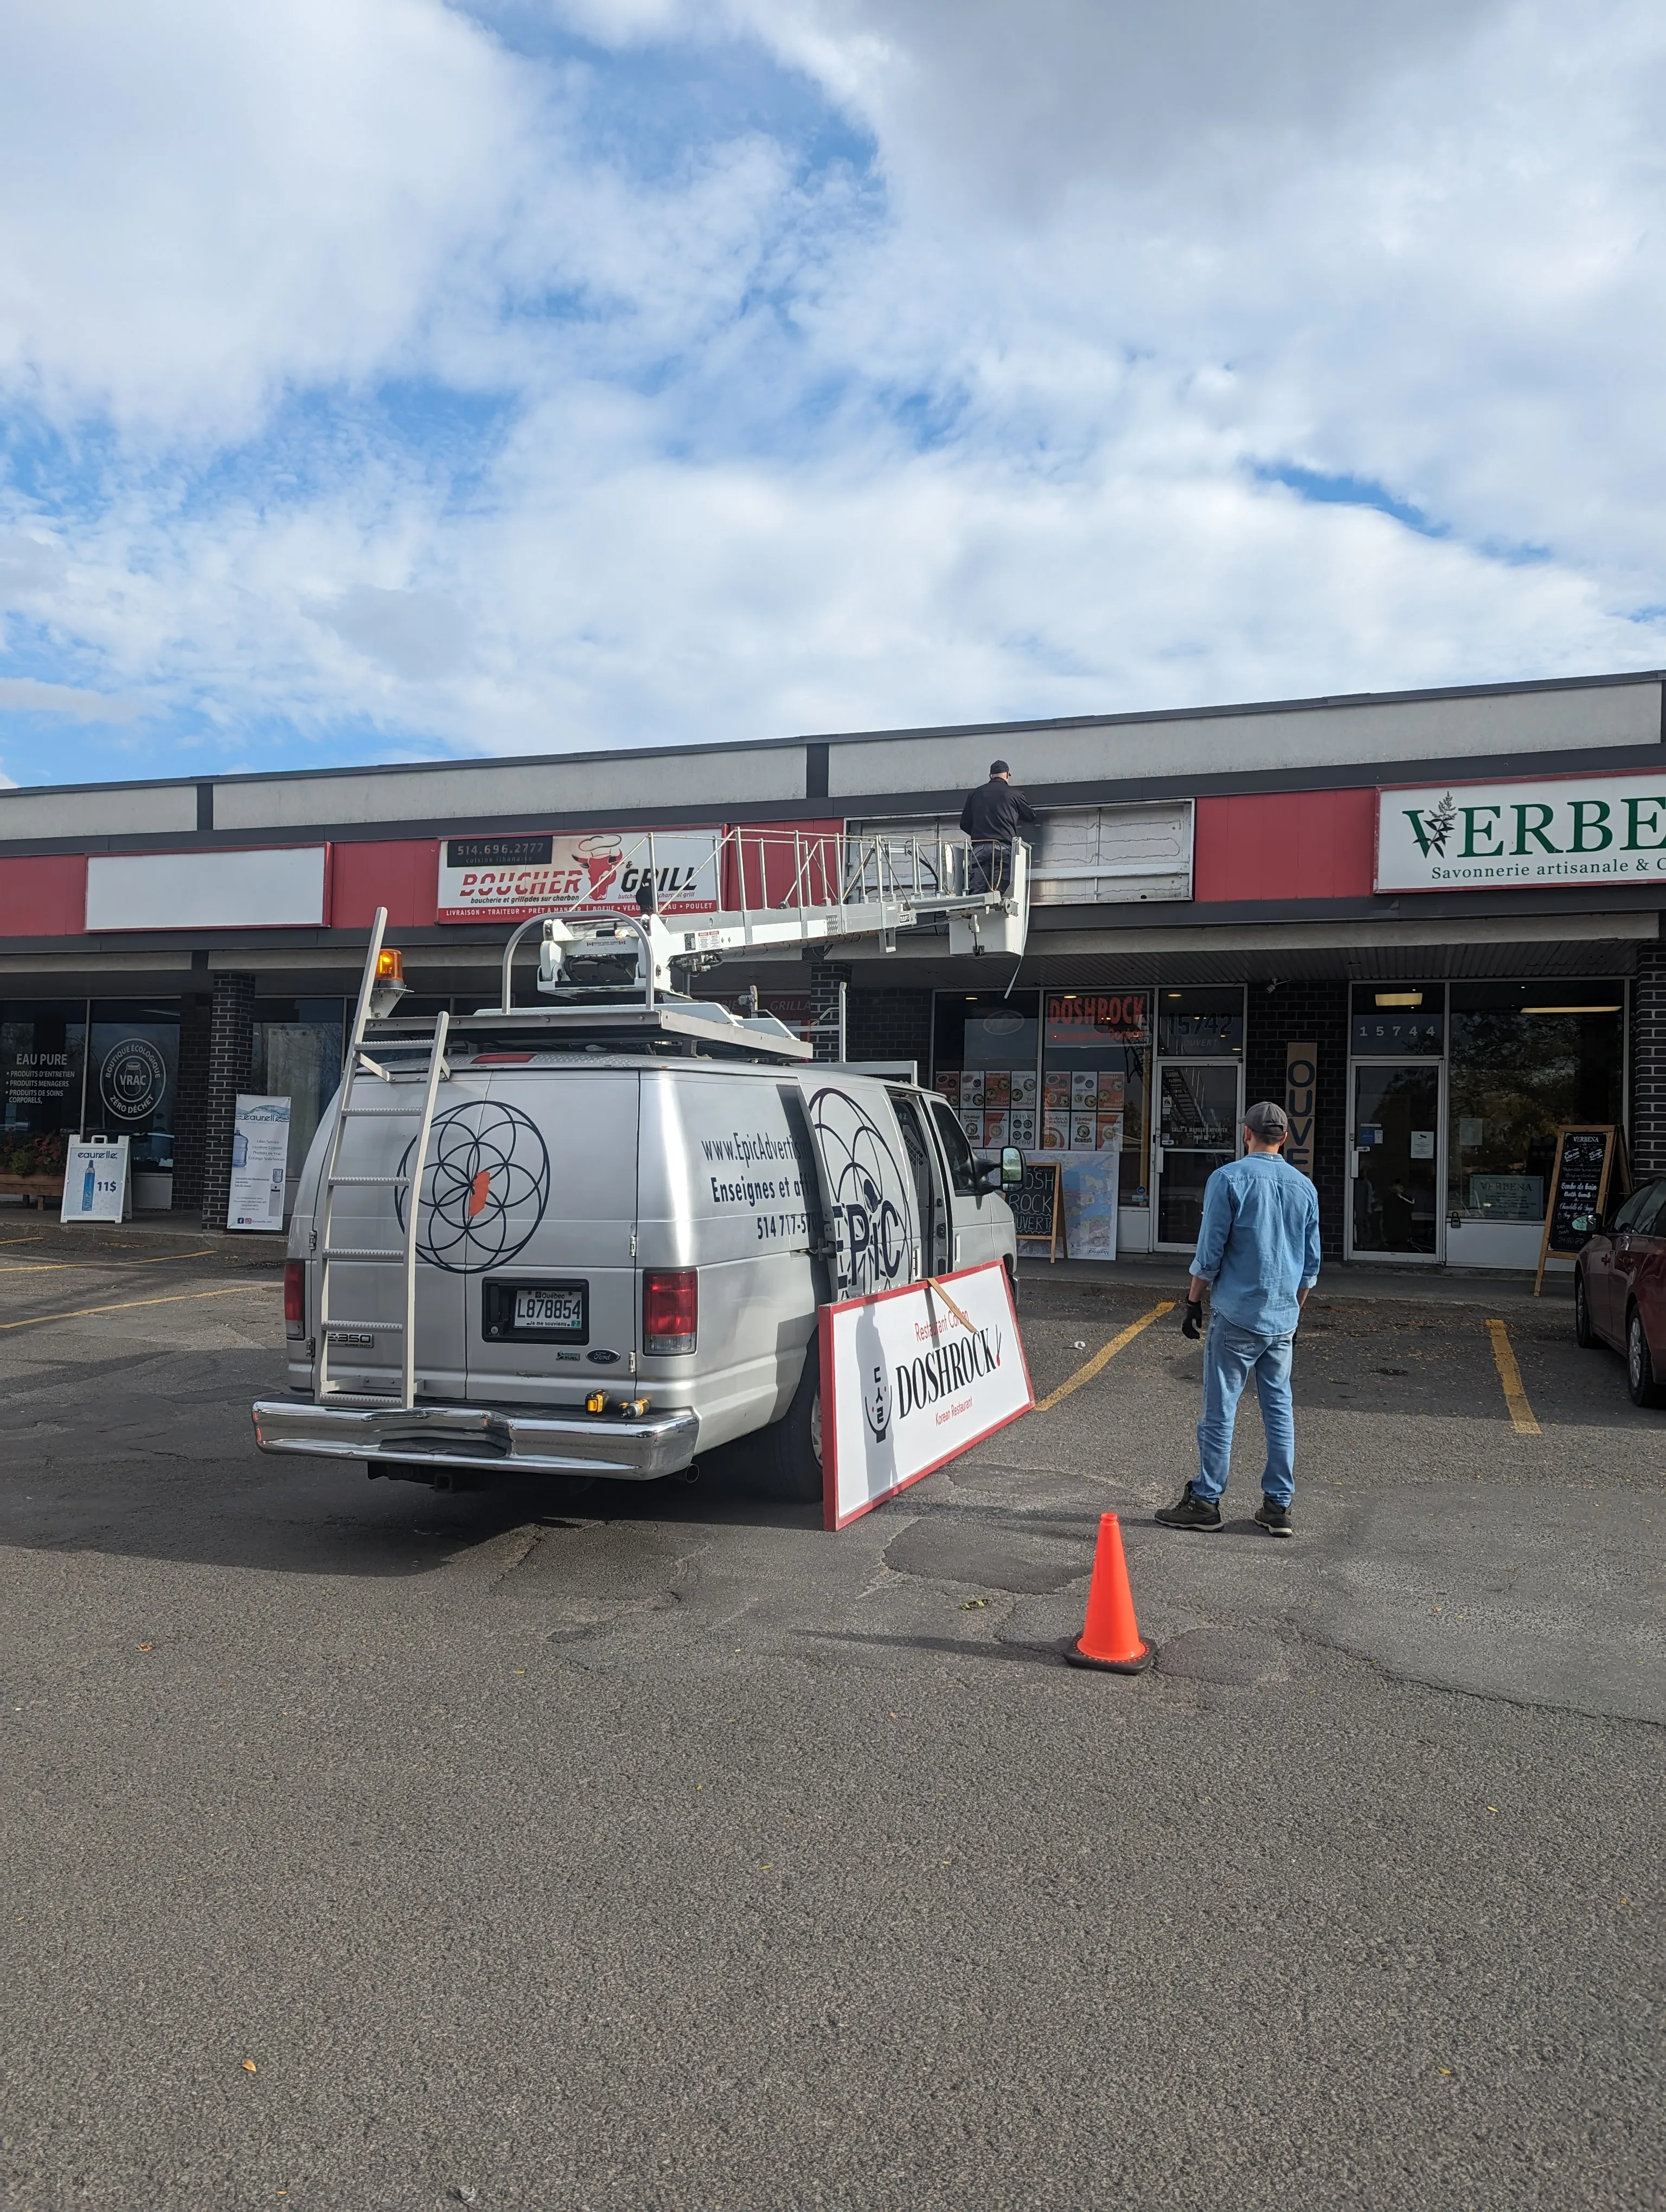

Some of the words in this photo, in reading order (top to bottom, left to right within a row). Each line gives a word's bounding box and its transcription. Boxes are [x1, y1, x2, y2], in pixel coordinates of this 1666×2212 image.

[458, 843, 544, 856] 514.696.2777
[1432, 863, 1529, 879] Savonnerie
[1537, 859, 1629, 875] artisanale
[1636, 858, 1650, 871] &
[459, 870, 583, 896] BOUCHER
[621, 867, 697, 892] GRILL
[511, 895, 539, 904] grillades
[1049, 996, 1144, 1026] DOSHROCK
[1168, 1012, 1232, 1036] 15742
[1360, 1026, 1436, 1036] 15744
[16, 1053, 37, 1065] EAU
[40, 1053, 67, 1065] PURE
[105, 1045, 131, 1078] BOUTIQUE
[131, 1043, 161, 1079] ÉCOLOGIQUE
[119, 1075, 146, 1085] VRAC
[110, 1094, 127, 1112] ZÉRO
[128, 1094, 154, 1114] DÉCHET
[244, 1114, 283, 1122] eaurelle
[77, 1150, 118, 1159] eaurelle
[98, 1181, 116, 1193] 11$
[710, 1175, 775, 1207] Enseignes
[779, 1176, 791, 1198] et
[1025, 1172, 1054, 1191] OSH
[1480, 1182, 1532, 1192] VERBENA
[1009, 1194, 1052, 1213] ROCK
[757, 1216, 776, 1240] 514
[779, 1213, 818, 1237] 717-570
[517, 1298, 581, 1319] L878854
[915, 1314, 948, 1342] Restaurant
[949, 1310, 970, 1329] Coren
[594, 1352, 612, 1361] Ford
[895, 1328, 997, 1419] DOSHROCK
[935, 1409, 951, 1426] Korean
[951, 1395, 973, 1417] Restaurant
